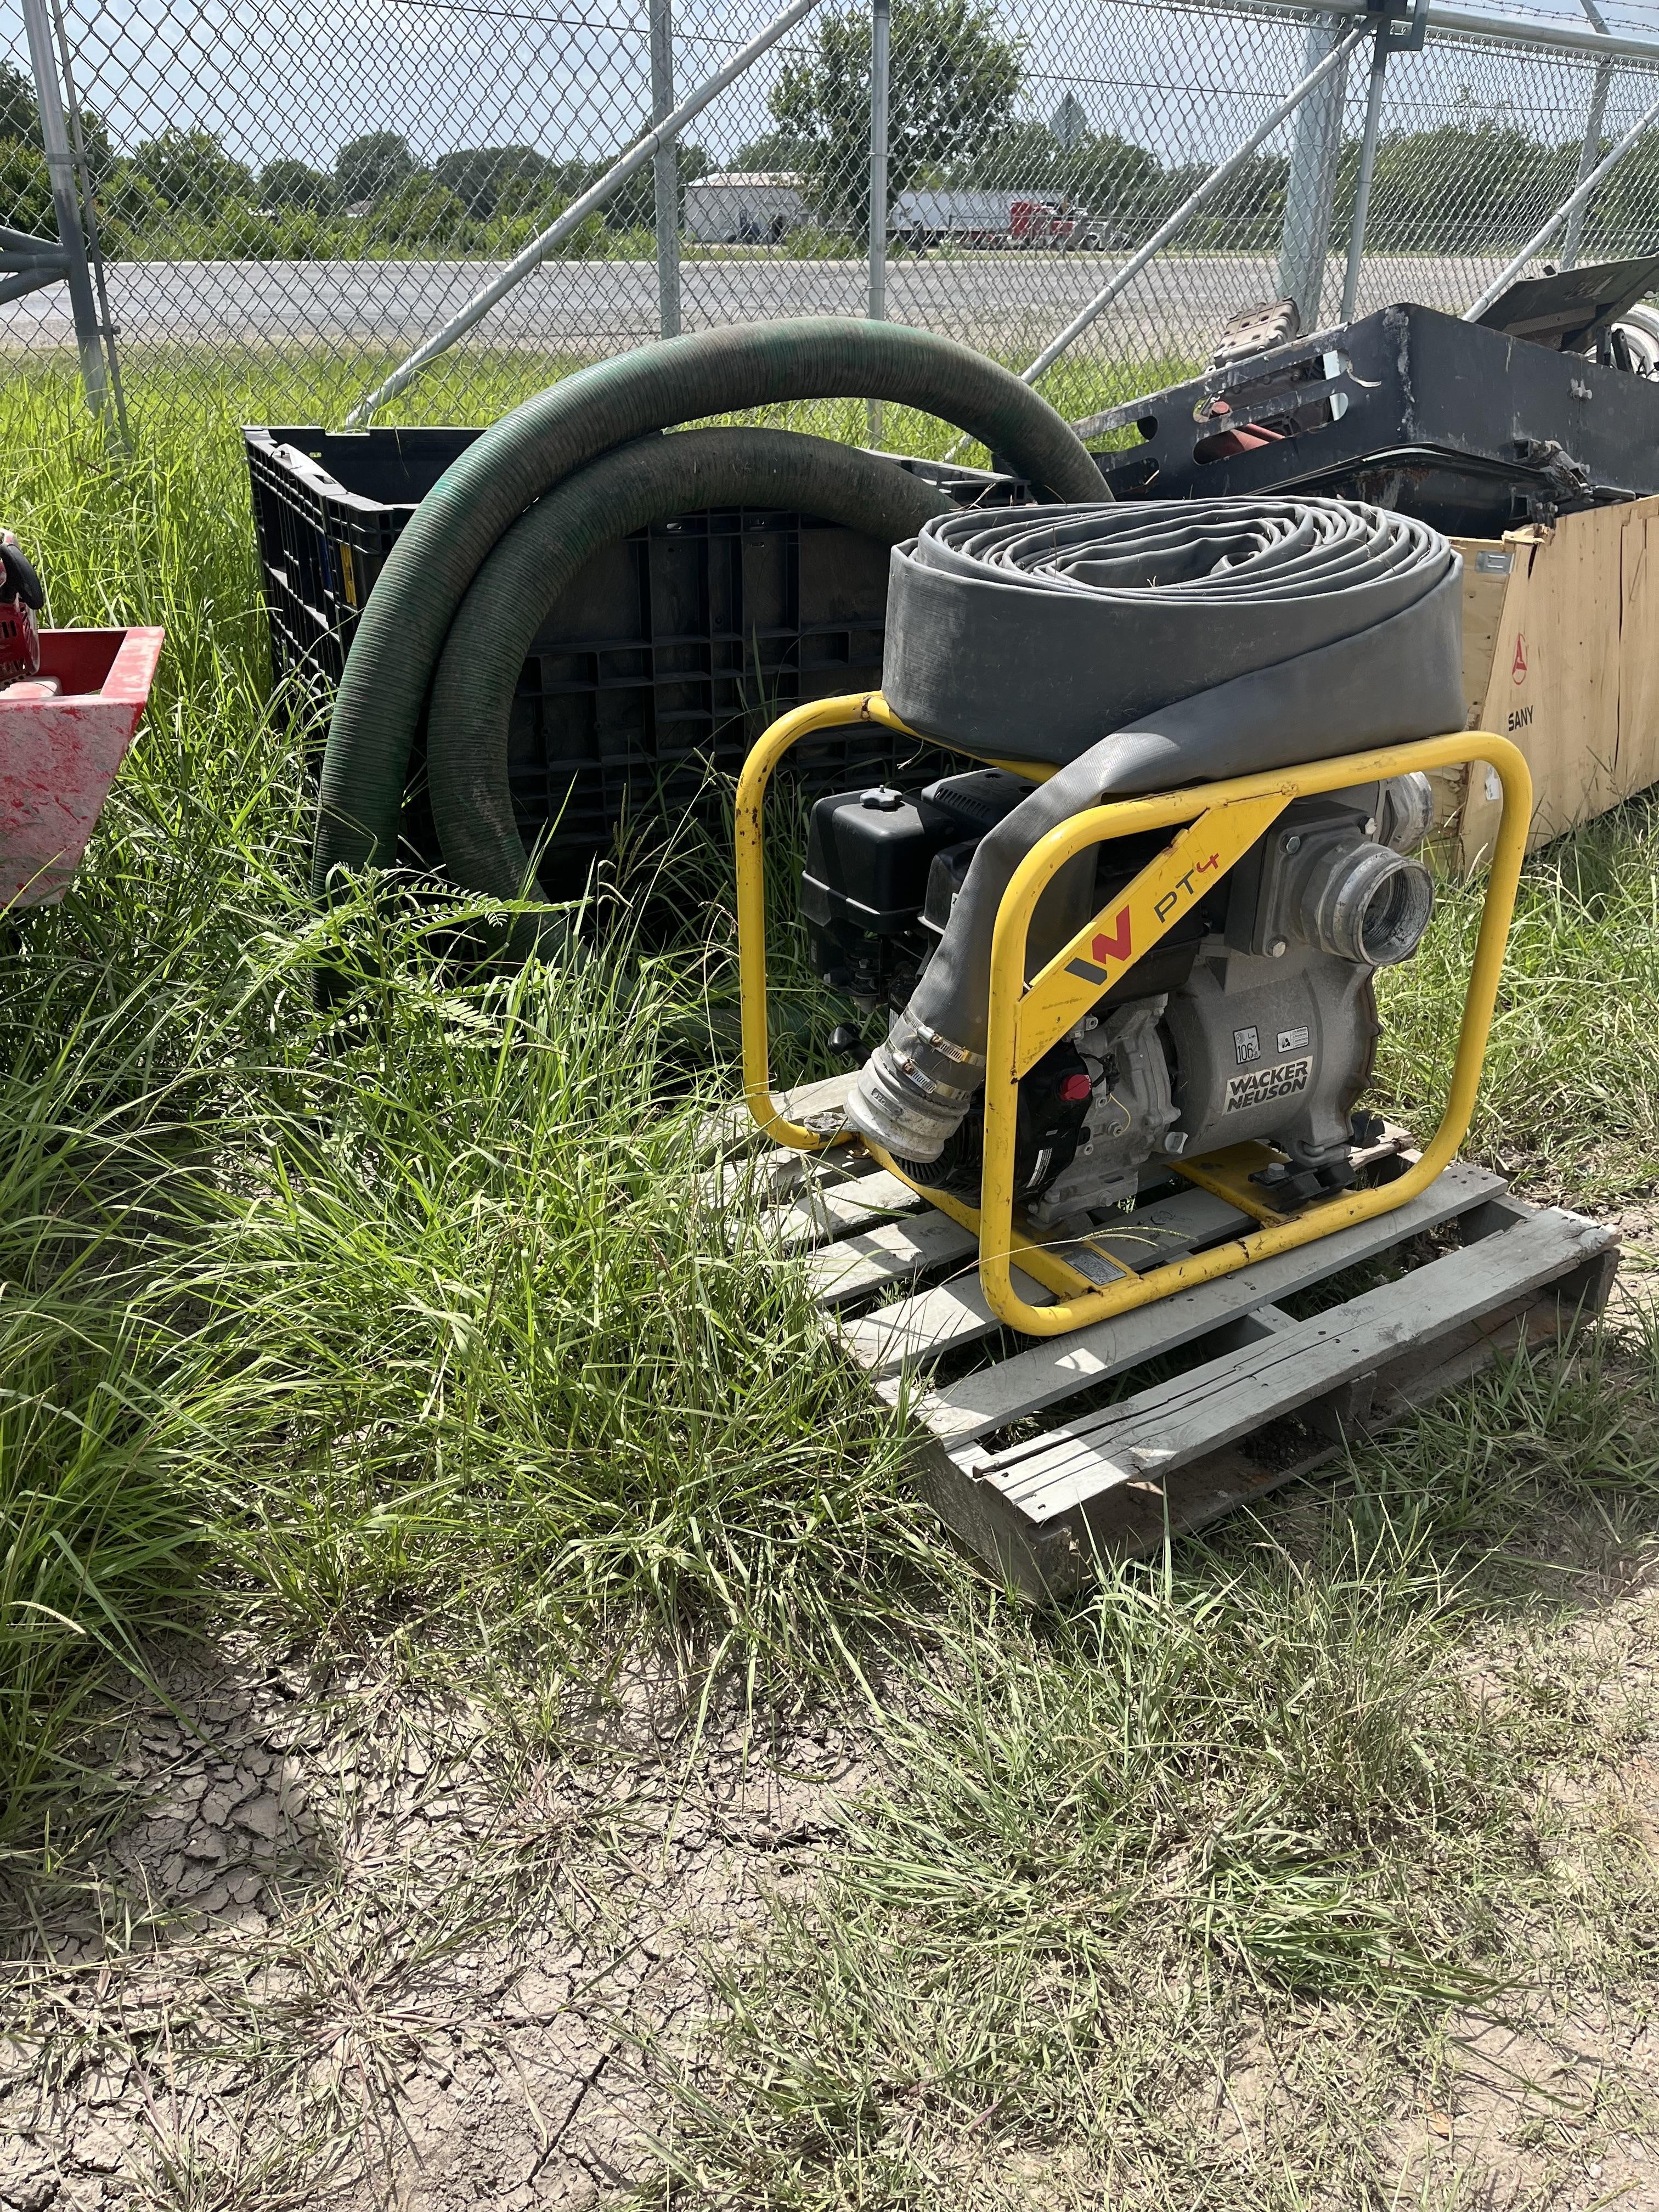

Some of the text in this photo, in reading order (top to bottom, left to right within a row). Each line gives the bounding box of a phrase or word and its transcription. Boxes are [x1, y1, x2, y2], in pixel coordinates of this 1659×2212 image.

[1508, 705, 1533, 731] SANY
[1154, 853, 1219, 923] PT4
[1237, 1042, 1254, 1062] 106
[1227, 1076, 1307, 1112] NEUSON
[1229, 1061, 1308, 1096] WACKER
